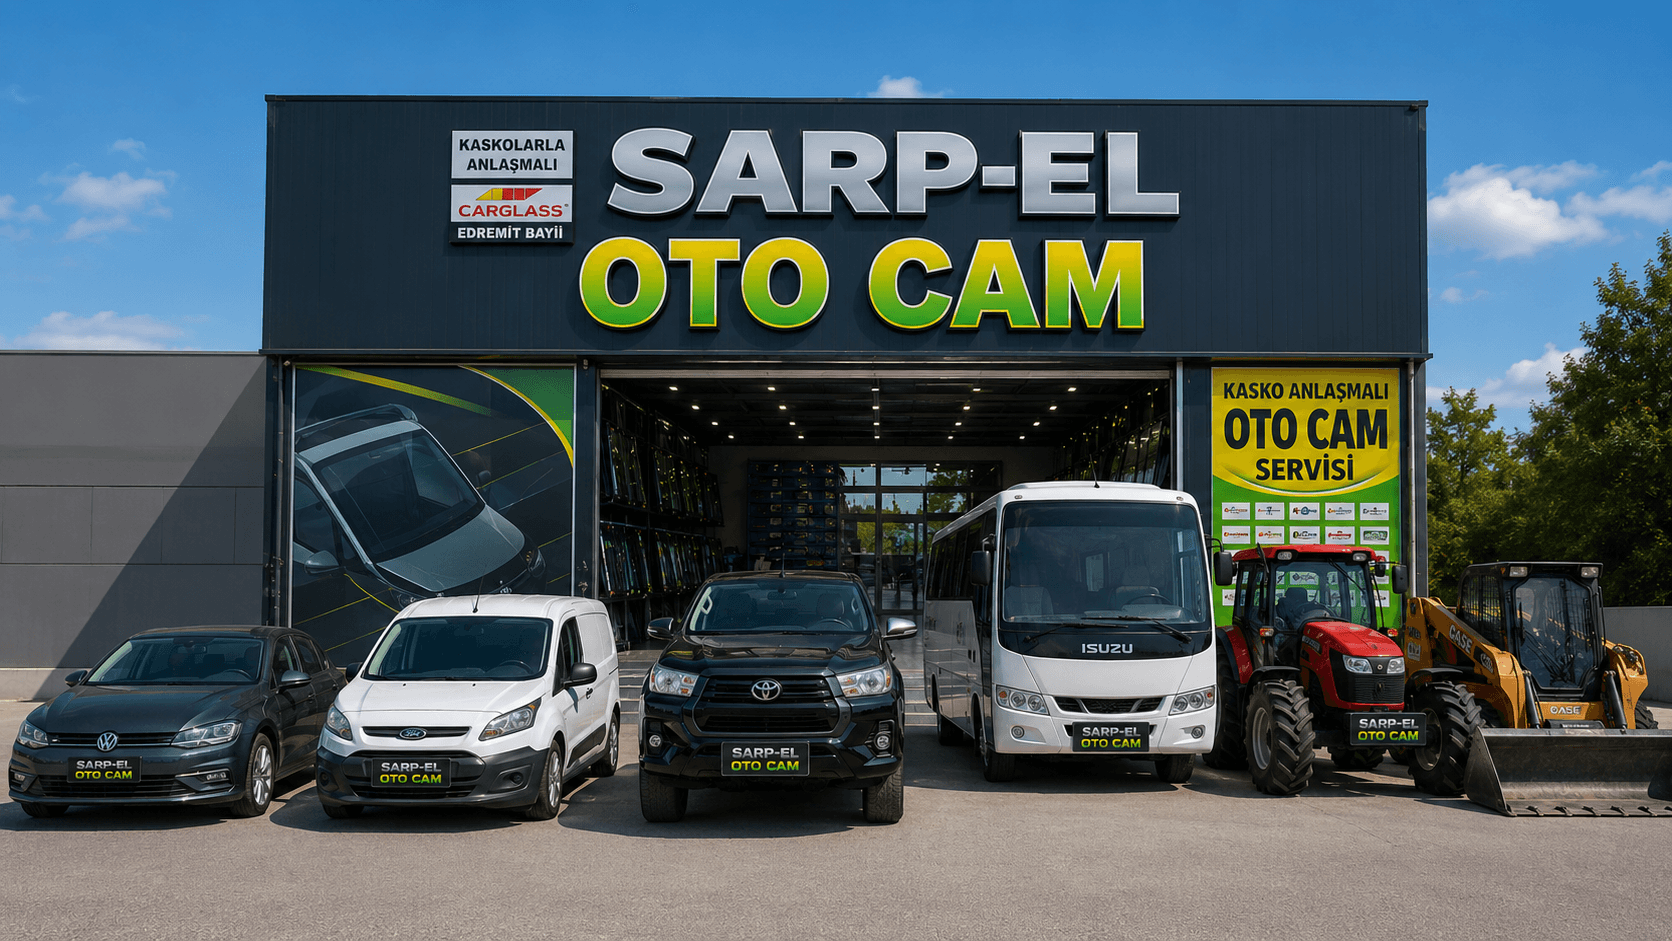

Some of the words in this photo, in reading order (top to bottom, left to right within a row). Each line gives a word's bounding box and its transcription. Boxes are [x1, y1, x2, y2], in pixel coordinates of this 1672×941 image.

[459, 138, 566, 152] KASKOLARLA
[466, 158, 558, 174] ANLAŞMALI
[606, 126, 1181, 216] SARP-EL
[457, 225, 521, 239] EDREMİT
[579, 236, 830, 329] OTO
[868, 236, 1145, 330] CAM
[1223, 382, 1284, 400] KASKO
[1288, 382, 1389, 403] ANLAŞMALI
[1223, 407, 1298, 450] OTO
[1307, 407, 1388, 450] CAM
[1255, 453, 1354, 481] SERVİSİ
[1082, 643, 1133, 654] ISUZU
[1358, 718, 1419, 729] SARP-EL
[1082, 726, 1141, 737] SARP-EL
[1357, 730, 1385, 741] OTO
[1389, 730, 1419, 741] CAM
[1080, 738, 1109, 748] OTO
[1112, 738, 1141, 748] CAM
[731, 747, 799, 758] SARP-EL
[76, 760, 132, 770] SARP-EL
[381, 762, 442, 772] SARP-EL
[730, 760, 761, 771] OTO
[766, 760, 799, 771] CAM
[75, 770, 102, 780] OTO
[105, 770, 132, 780] CAM
[379, 773, 408, 784] OTO
[411, 773, 442, 784] CAM
